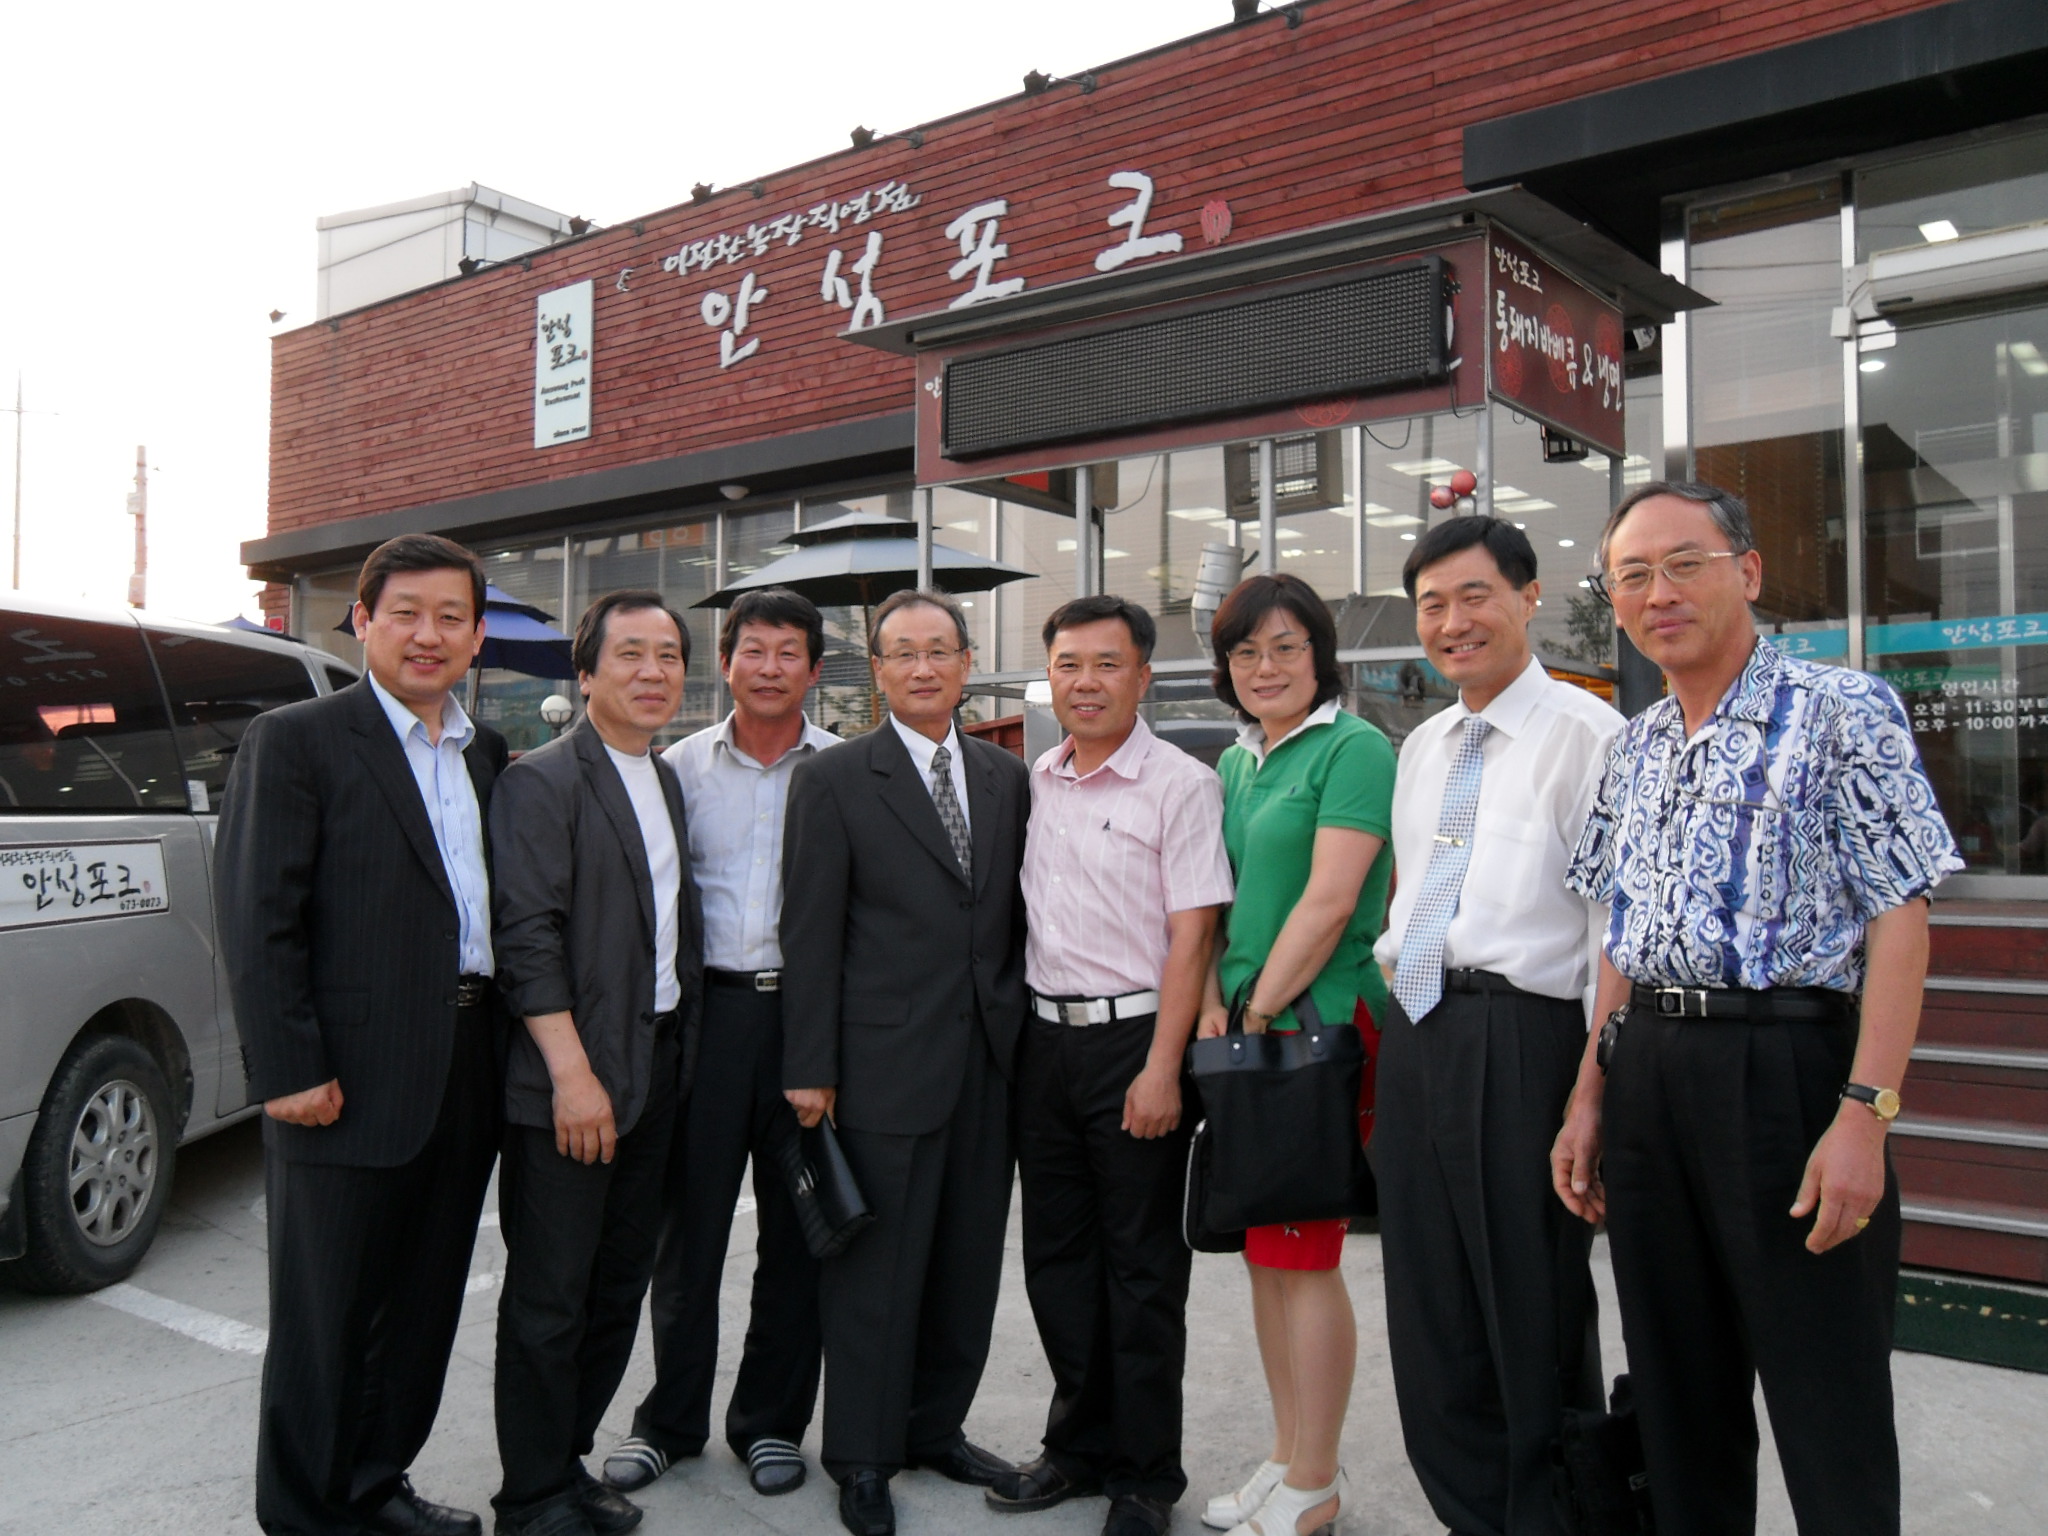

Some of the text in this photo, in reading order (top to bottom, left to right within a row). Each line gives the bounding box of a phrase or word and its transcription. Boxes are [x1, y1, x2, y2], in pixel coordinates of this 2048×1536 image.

[701, 171, 1182, 368] 안성포크
[1494, 246, 1543, 294] 안성포크
[541, 313, 572, 343] 안성
[550, 343, 582, 370] 포크
[1582, 343, 1593, 387] &
[1597, 354, 1621, 412] 냉면
[1942, 620, 2048, 645] 안성포크
[1941, 678, 2020, 697] 영업시간
[1913, 702, 1946, 716] 오전
[1966, 699, 2014, 714] 11:30
[1914, 718, 1947, 732] 오후
[1966, 716, 2014, 731] 10:00
[23, 862, 141, 911] 안성포크
